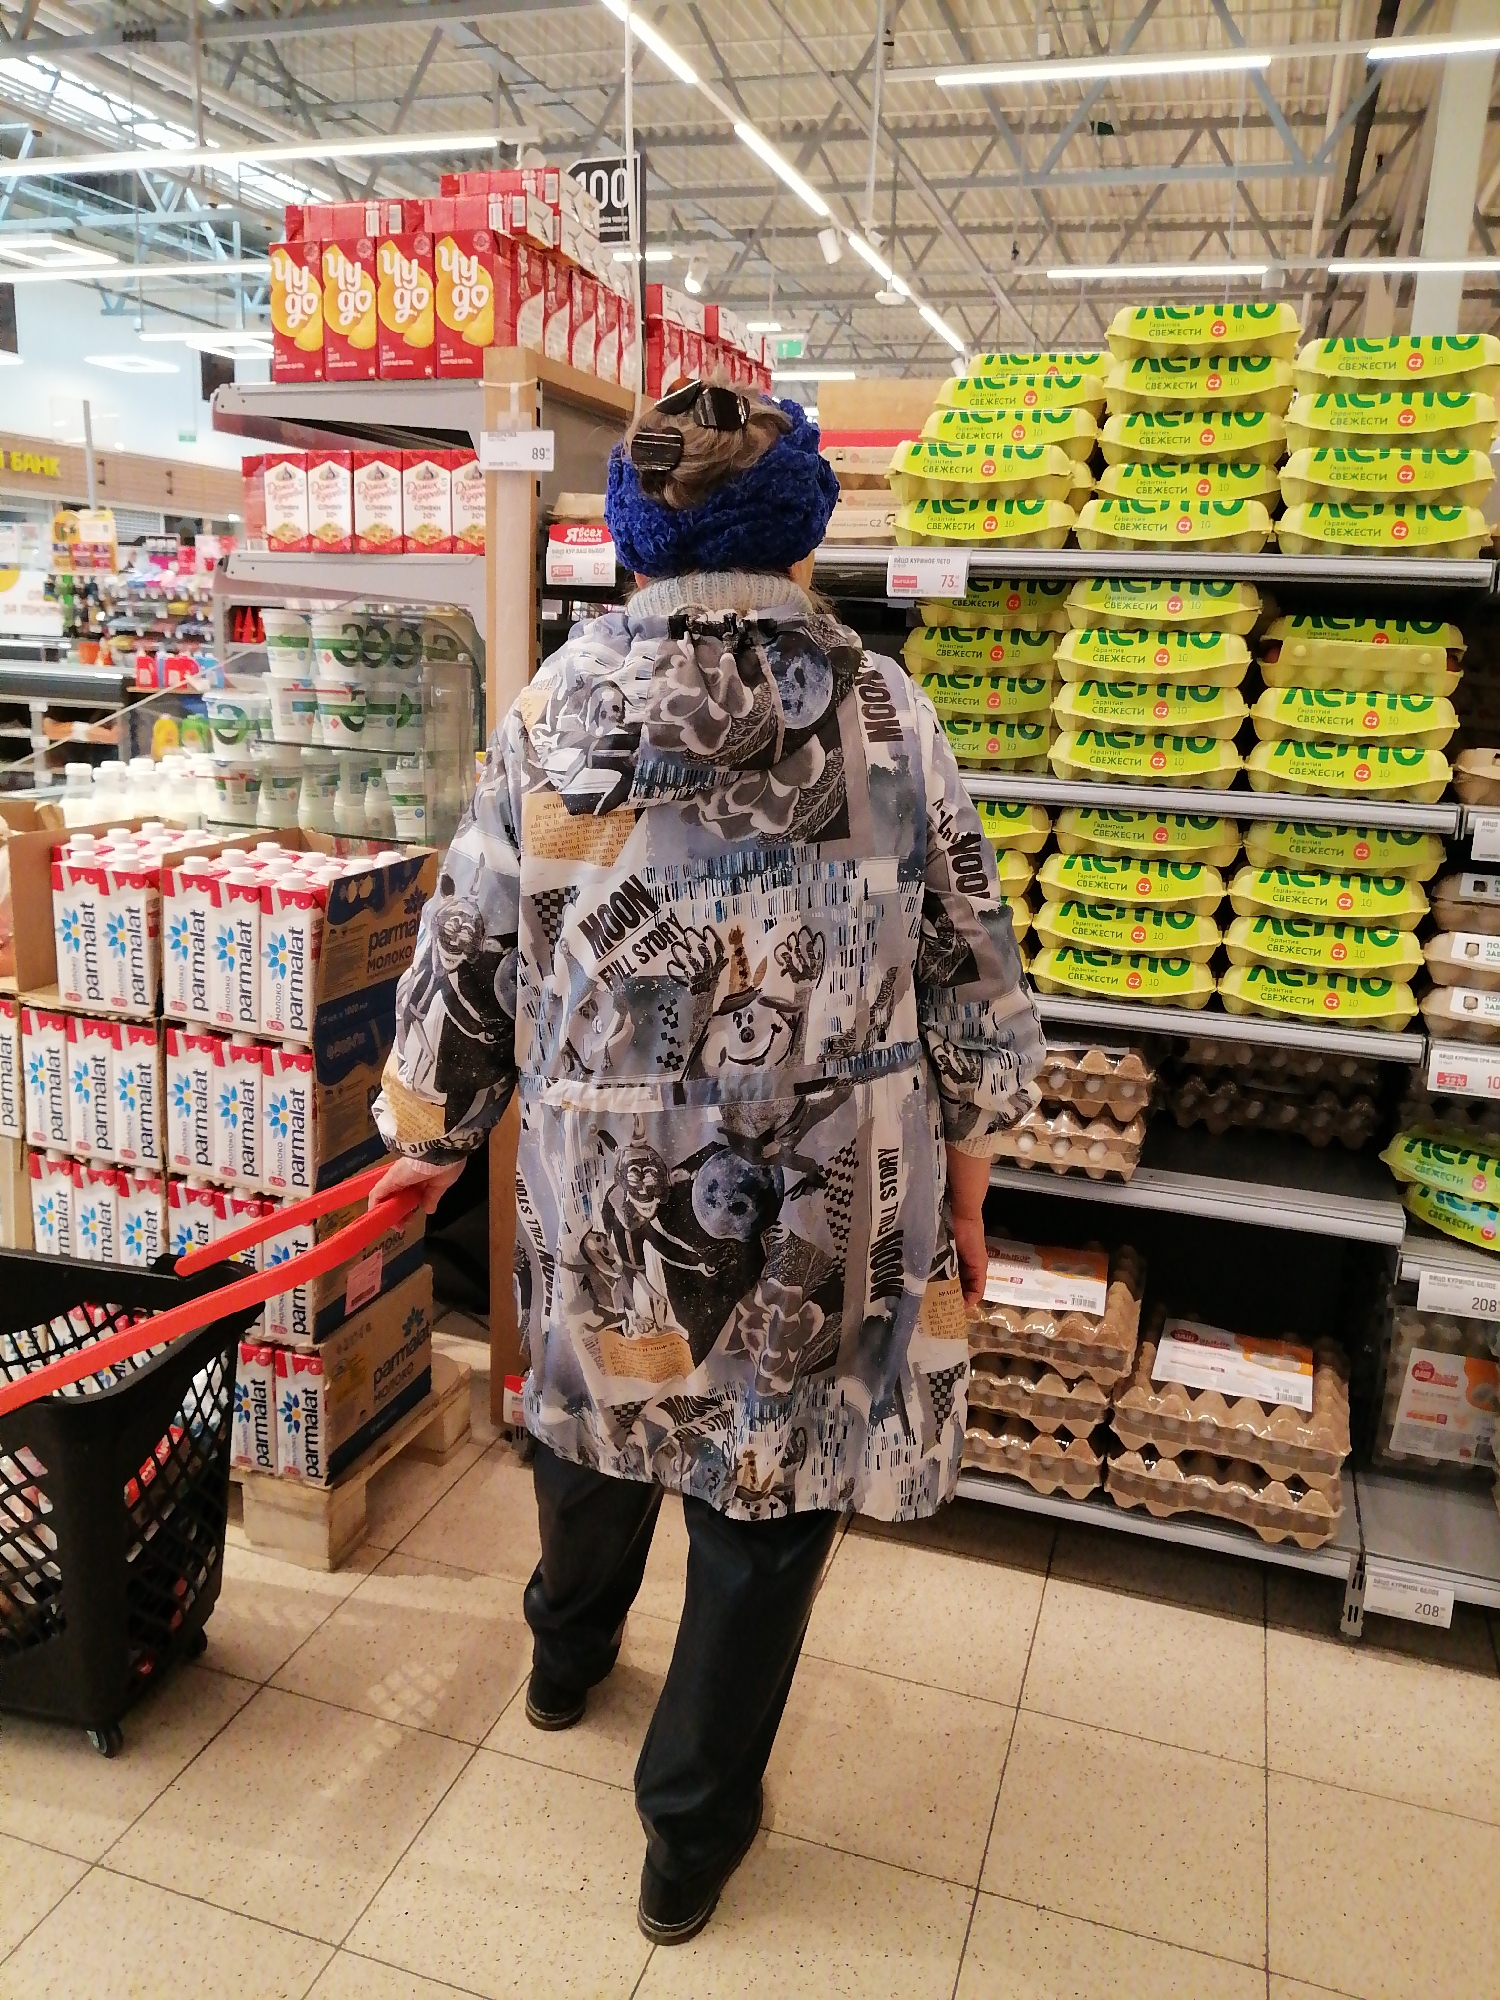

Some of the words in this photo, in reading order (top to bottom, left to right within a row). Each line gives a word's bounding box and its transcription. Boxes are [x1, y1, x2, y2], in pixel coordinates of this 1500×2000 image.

[1149, 329, 1202, 337] СВЕЖЕСТИ
[1338, 362, 1397, 370] СВЕЖЕСТИ
[1145, 381, 1197, 390] СВЕЖЕСТИ
[1330, 418, 1388, 426] СВЕЖЕСТИ
[956, 432, 1003, 440] СВЕЖЕСТИ
[1139, 437, 1191, 445] СВЕЖЕСТИ
[532, 447, 545, 460] 89
[10, 452, 60, 477] БАНК
[923, 466, 973, 474] СВЕЖЕСТИ
[1329, 473, 1387, 481] СВЕЖЕСТИ
[1114, 523, 1167, 531] СВЕЖЕСТИ
[1323, 529, 1382, 537] СВЕЖЕСТИ
[941, 574, 954, 588] 73
[952, 600, 999, 608] СВЕЖЕСТИ
[1104, 602, 1158, 610] СВЕЖЕСТИ
[936, 649, 983, 659] СВЕЖЕСТИ
[1092, 655, 1145, 663] СВЕЖЕСТИ
[933, 697, 980, 705] СВЕЖЕСТИ
[1092, 707, 1145, 716] СВЕЖЕСТИ
[1297, 715, 1354, 725] СВЕЖЕСТИ
[1090, 756, 1142, 766] СВЕЖЕСТИ
[1289, 768, 1344, 778] СВЕЖЕСТИ
[1093, 829, 1145, 840] СВЕЖЕСТИ
[1289, 845, 1344, 856] СВЕЖЕСТИ
[1076, 880, 1127, 891] СВЕЖЕСТИ
[1272, 894, 1328, 906] СВЕЖЕСТИ
[578, 873, 662, 959] MOON
[1072, 927, 1123, 939] СВЕЖЕСТИ
[80, 900, 104, 1000] parmalat
[125, 905, 150, 1006] parmalat
[598, 948, 641, 993] FULL
[638, 911, 688, 965] STORY
[1267, 944, 1321, 956] СВЕЖЕСТИ
[190, 908, 209, 1012] parmalat
[236, 918, 257, 1023] parmalat
[288, 925, 308, 1031] parmalat
[1068, 972, 1119, 984] СВЕЖЕСТИ
[1260, 993, 1314, 1005] СВЕЖЕСТИ
[46, 1046, 68, 1142] parmalat
[91, 1054, 113, 1150] parmalat
[137, 1062, 159, 1159] parmalat
[192, 1068, 213, 1166] parmalat
[239, 1078, 260, 1177] parmalat
[289, 1087, 310, 1187] parmalat
[877, 1147, 899, 1202] STORY
[877, 1201, 899, 1237] FULL
[870, 1229, 904, 1303] MOON
[1472, 1297, 1497, 1313] 208
[250, 1377, 273, 1468] parmalat
[302, 1387, 323, 1479] parmalat
[1414, 1602, 1439, 1618] 208
